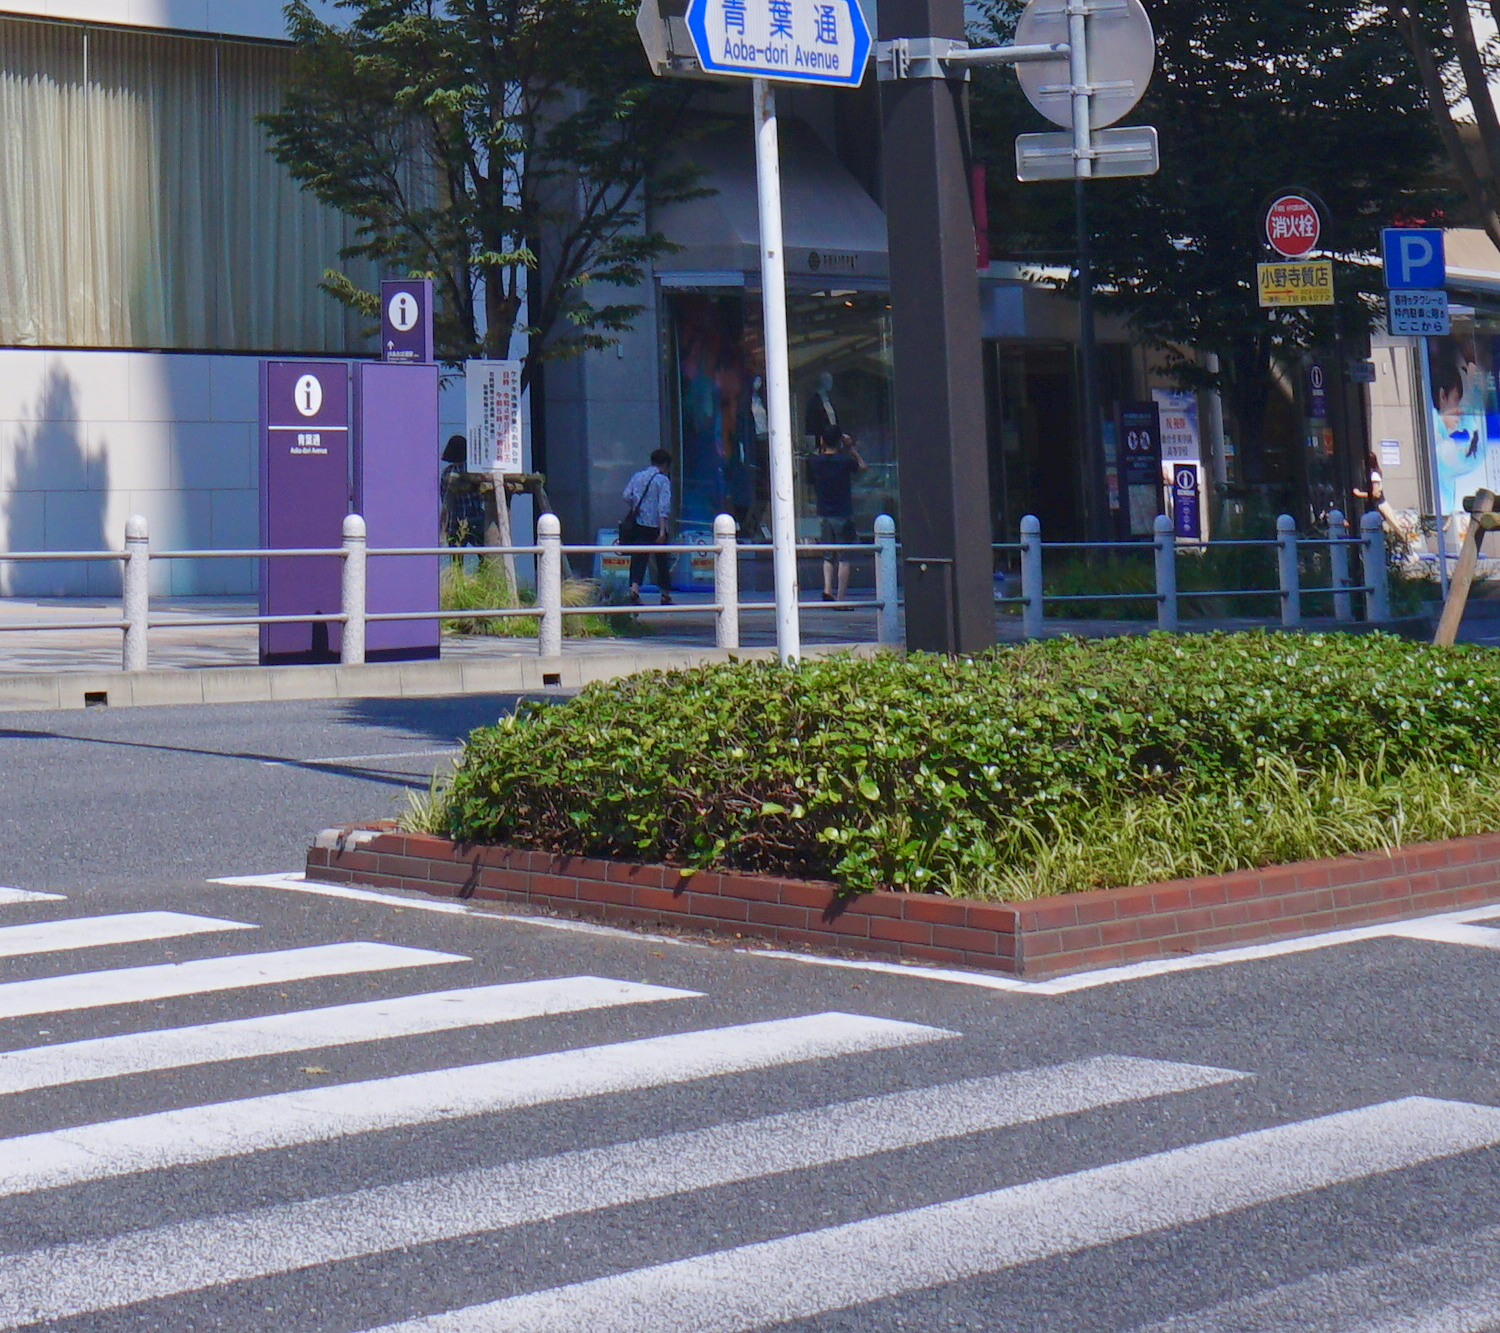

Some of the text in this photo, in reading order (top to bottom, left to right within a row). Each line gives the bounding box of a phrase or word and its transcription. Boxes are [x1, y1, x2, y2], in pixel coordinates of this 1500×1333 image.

[724, 36, 839, 71] Aoba-dori Avenue
[1271, 214, 1315, 239] 消火栓
[1400, 235, 1433, 282] P
[1261, 267, 1328, 288] 小野寺質店
[1399, 321, 1443, 332] ここから
